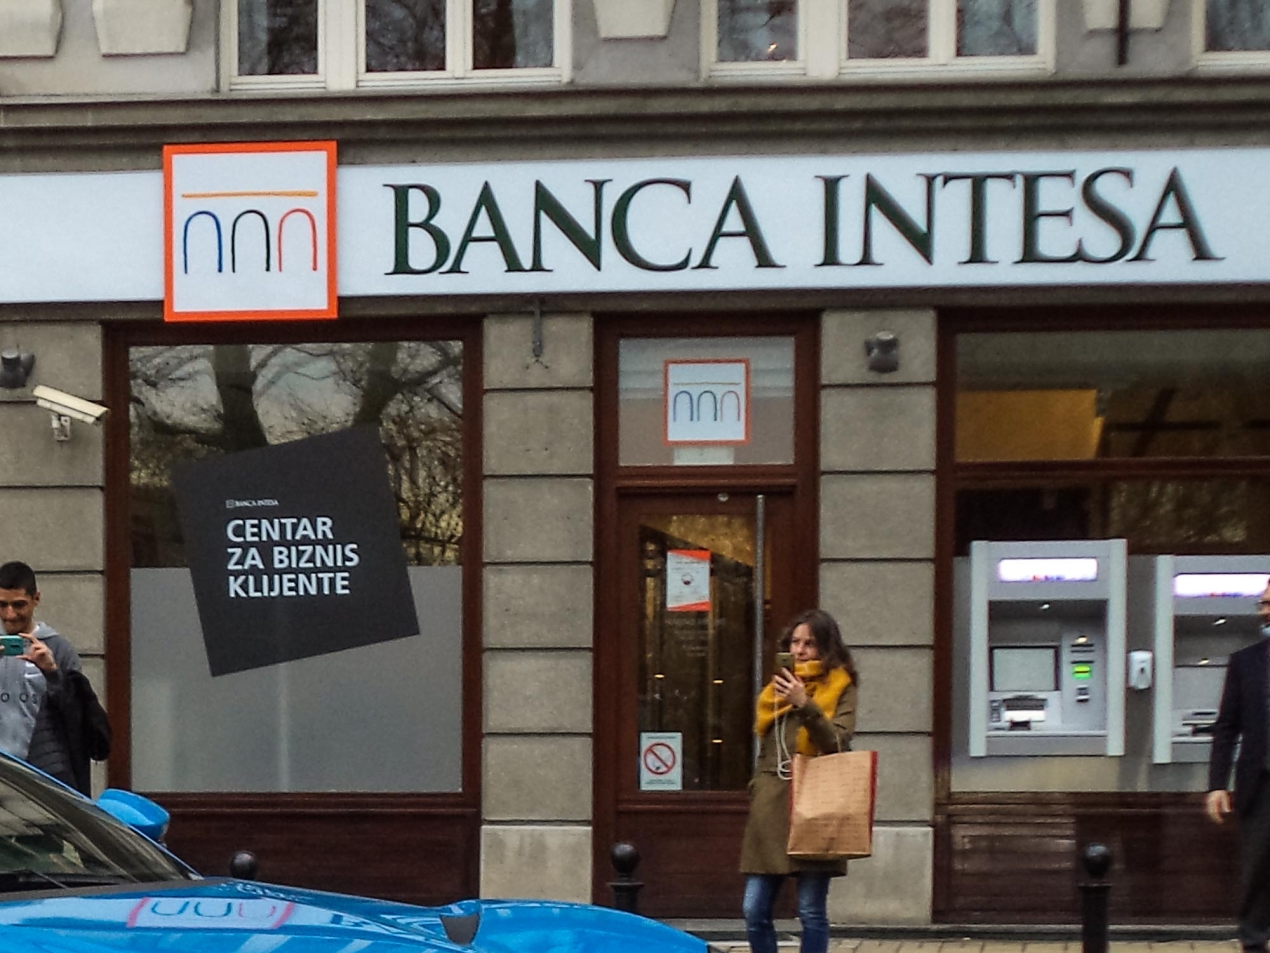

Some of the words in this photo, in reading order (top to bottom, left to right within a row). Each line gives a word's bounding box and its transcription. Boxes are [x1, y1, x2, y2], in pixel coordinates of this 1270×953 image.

[382, 175, 787, 276] BANCA
[813, 166, 1226, 268] INTESA
[226, 516, 334, 542] CENTAR
[226, 547, 264, 570] ZA
[272, 543, 360, 569] BIZNIS
[228, 572, 351, 598] KLIJENTE
